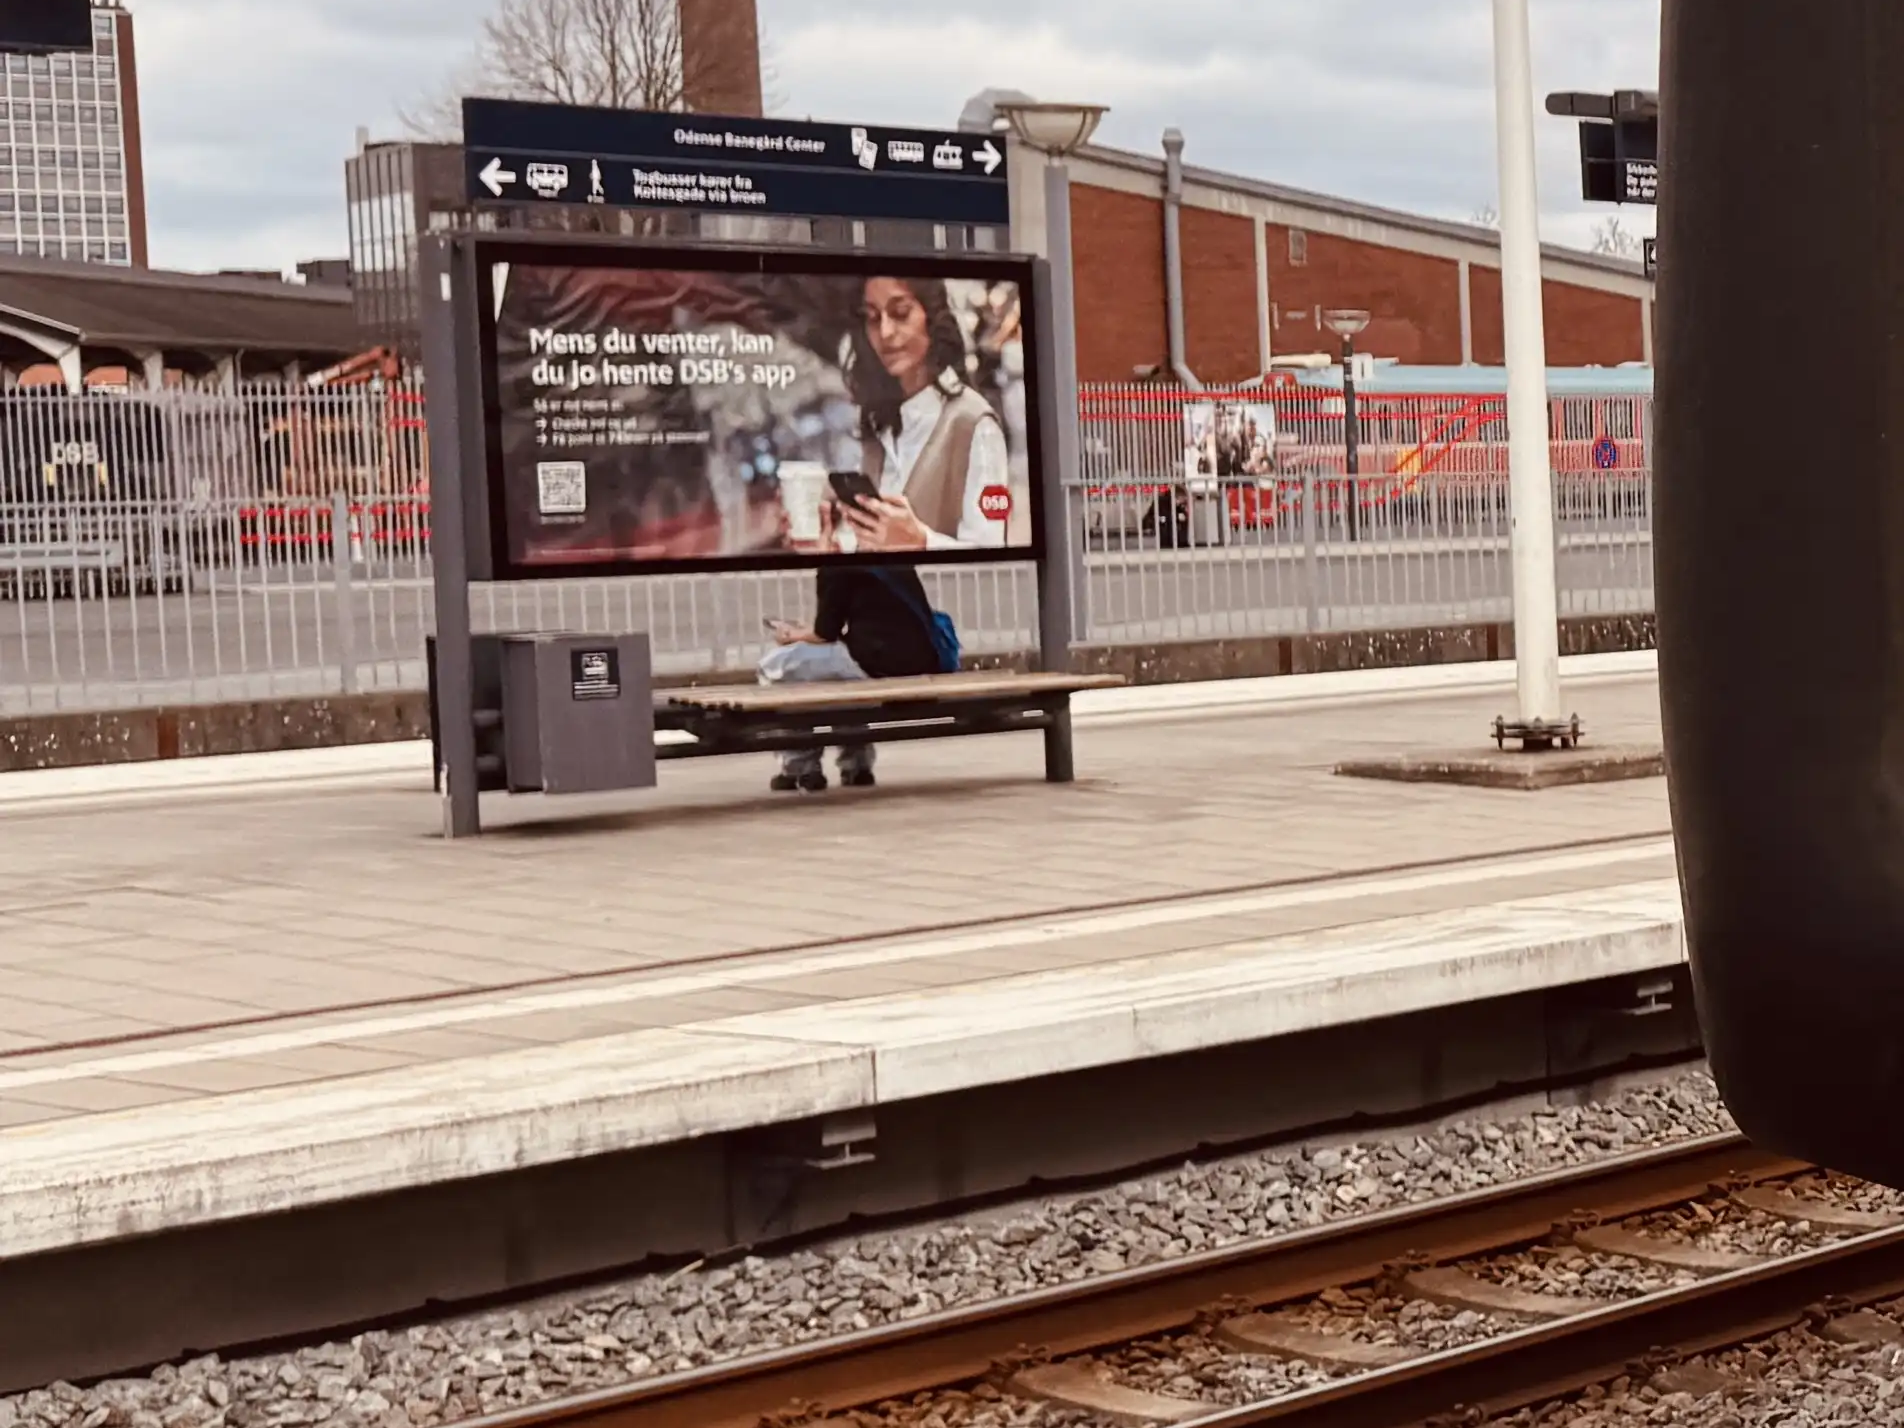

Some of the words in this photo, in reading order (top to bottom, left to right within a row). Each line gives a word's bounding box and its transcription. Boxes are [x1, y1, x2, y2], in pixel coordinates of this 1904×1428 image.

[674, 129, 723, 146] Odense
[785, 136, 827, 153] Center
[529, 328, 597, 355] Mens
[603, 327, 637, 355] du
[642, 331, 726, 357] venter,
[731, 328, 774, 355] kan
[532, 359, 566, 386] du
[571, 361, 597, 390] jo
[603, 358, 673, 386] hente
[680, 359, 745, 385] DSB's
[752, 363, 796, 390] app
[982, 495, 1008, 510] DSB
